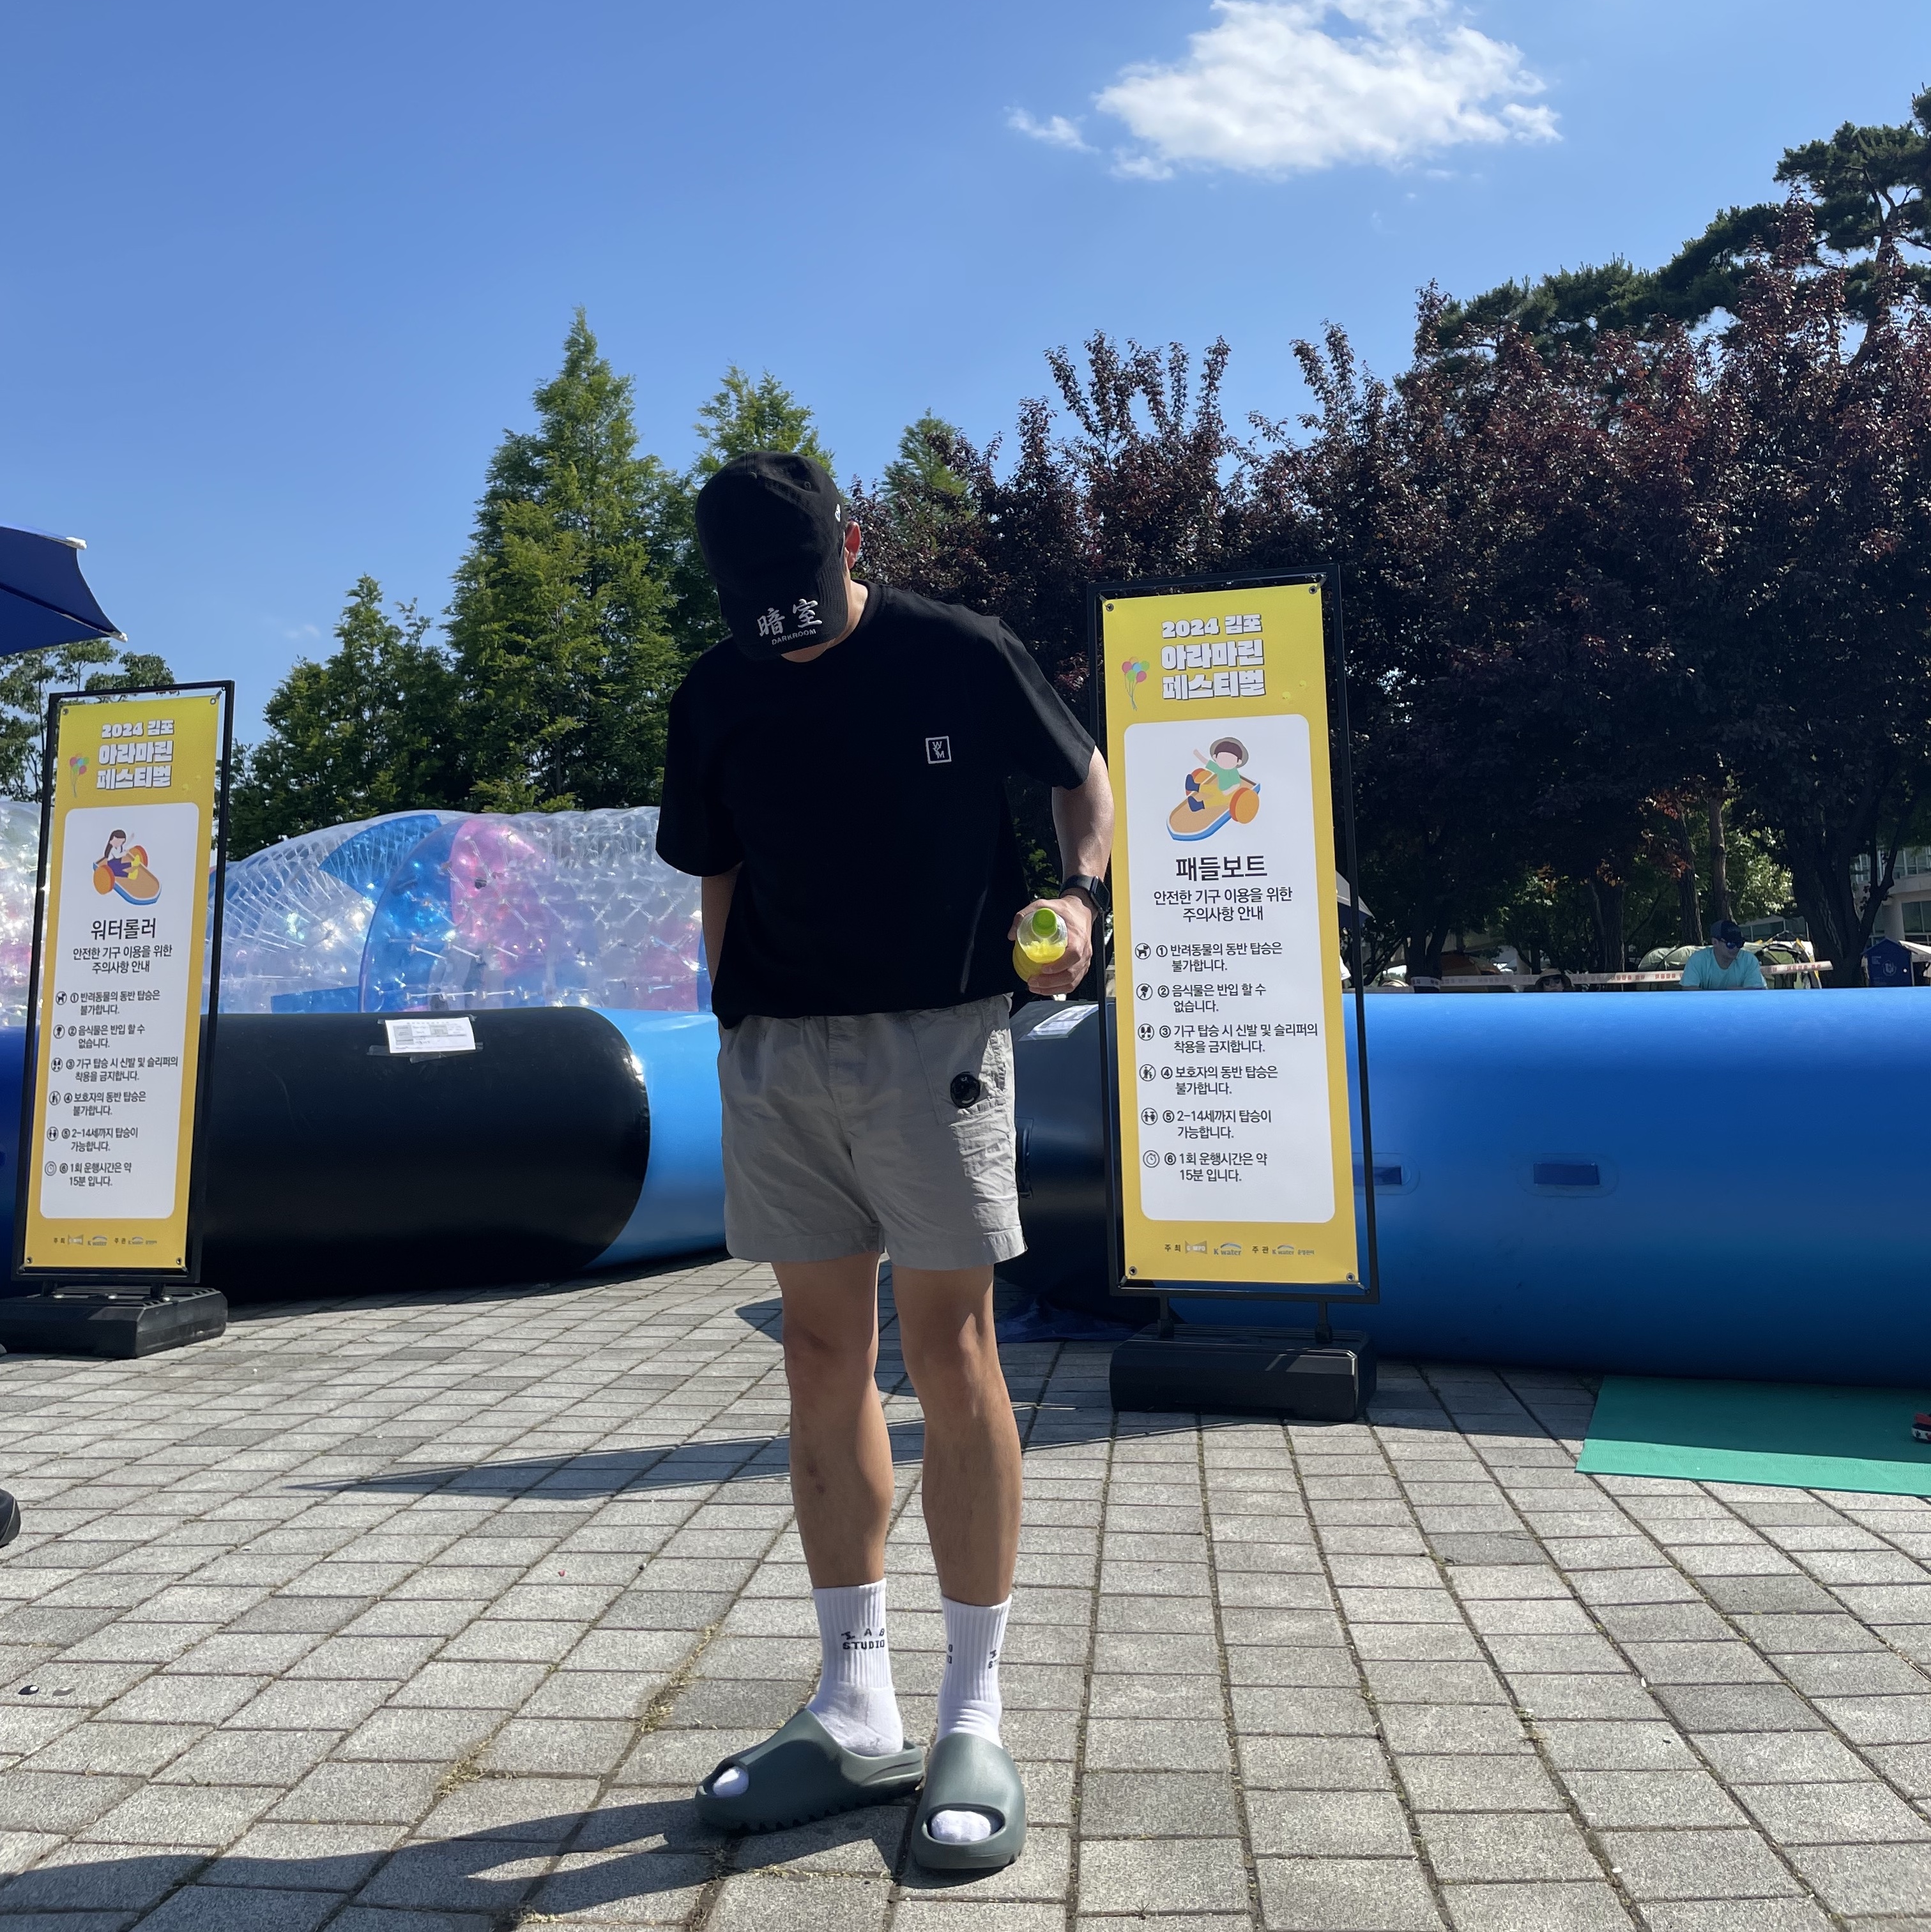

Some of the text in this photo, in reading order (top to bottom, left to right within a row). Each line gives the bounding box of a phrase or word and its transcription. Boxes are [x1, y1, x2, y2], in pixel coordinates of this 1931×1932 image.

[757, 598, 823, 637] 暗室
[1161, 614, 1262, 638] 2024 김포
[772, 628, 816, 645] DARKROOM
[1161, 639, 1264, 670] 아라마린
[1162, 669, 1266, 700] 페스티벌
[102, 719, 174, 738] 2024 김포
[98, 740, 174, 765] 아라마린
[96, 765, 172, 790] 페스티벌
[1176, 855, 1267, 881] 패들보트
[1154, 886, 1292, 905] 안전한 기구 이용을 위한
[1183, 906, 1263, 922] 주의사항 안내
[91, 918, 156, 940] 워터롤러
[73, 944, 172, 960] 안전한 기구 이용을 위한
[1170, 943, 1223, 957] 반려동물의
[1225, 943, 1247, 955] 동반
[1250, 942, 1283, 955] 탑승은
[92, 960, 150, 974] 주의사항 안내
[1172, 959, 1228, 972] 불가합니다.
[80, 991, 118, 1003] 반려동물의
[120, 991, 135, 1001] 동반
[137, 990, 160, 1001] 탑승은
[1172, 984, 1214, 998] 음식물은
[1217, 984, 1238, 996] 반입
[1241, 984, 1253, 996] 할
[1255, 983, 1266, 996] 수
[80, 1005, 120, 1015] 불가합니다.
[1173, 1000, 1219, 1013] 없습니다.
[79, 1025, 108, 1036] 음식물은
[111, 1024, 125, 1035] 반입
[128, 1024, 135, 1035] 할
[137, 1024, 145, 1035] 수
[1174, 1025, 1195, 1038] 기구
[1198, 1024, 1219, 1037] 탑승
[1222, 1024, 1233, 1037] 시
[1236, 1024, 1257, 1037] 신발
[1261, 1024, 1271, 1037] 및
[1274, 1023, 1318, 1037] 슬리퍼의
[79, 1038, 110, 1049] 없습니다.
[1174, 1040, 1265, 1053] 착용을 금지합니다.
[76, 1058, 91, 1069] 기구
[94, 1058, 109, 1069] 탑승
[111, 1058, 118, 1068] 시
[120, 1057, 135, 1068] 신발
[138, 1057, 145, 1068] 및
[148, 1056, 178, 1068] 슬리퍼의
[75, 1070, 139, 1082] 착용을 금지합니다.
[1175, 1066, 1217, 1079] 보호자의
[1221, 1066, 1242, 1079] 동반
[1246, 1065, 1278, 1079] 탑승은
[1175, 1082, 1232, 1095] 불가합니다.
[73, 1092, 104, 1102] 보호자의
[106, 1092, 121, 1102] 동반
[123, 1091, 147, 1102] 탑승은
[73, 1105, 112, 1116] 불가합니다.
[1177, 1109, 1236, 1123] 2-14세까지
[1239, 1109, 1271, 1123] 탑승이
[72, 1127, 114, 1139] 2-14세까지
[116, 1127, 138, 1138] 탑승이
[1178, 1126, 1234, 1139] 가능합니다.
[71, 1141, 111, 1152] 가능합니다.
[1179, 1152, 1196, 1166] 1회
[1199, 1152, 1253, 1166] 운행시간은
[1256, 1152, 1267, 1166] 약
[70, 1162, 82, 1173] 1회
[84, 1162, 122, 1173] 운행시간은
[124, 1162, 132, 1173] 약
[69, 1176, 112, 1187] 15분 입니다.
[1180, 1169, 1242, 1182] 15분 입니다.
[843, 1639, 885, 1650] STUDIO
